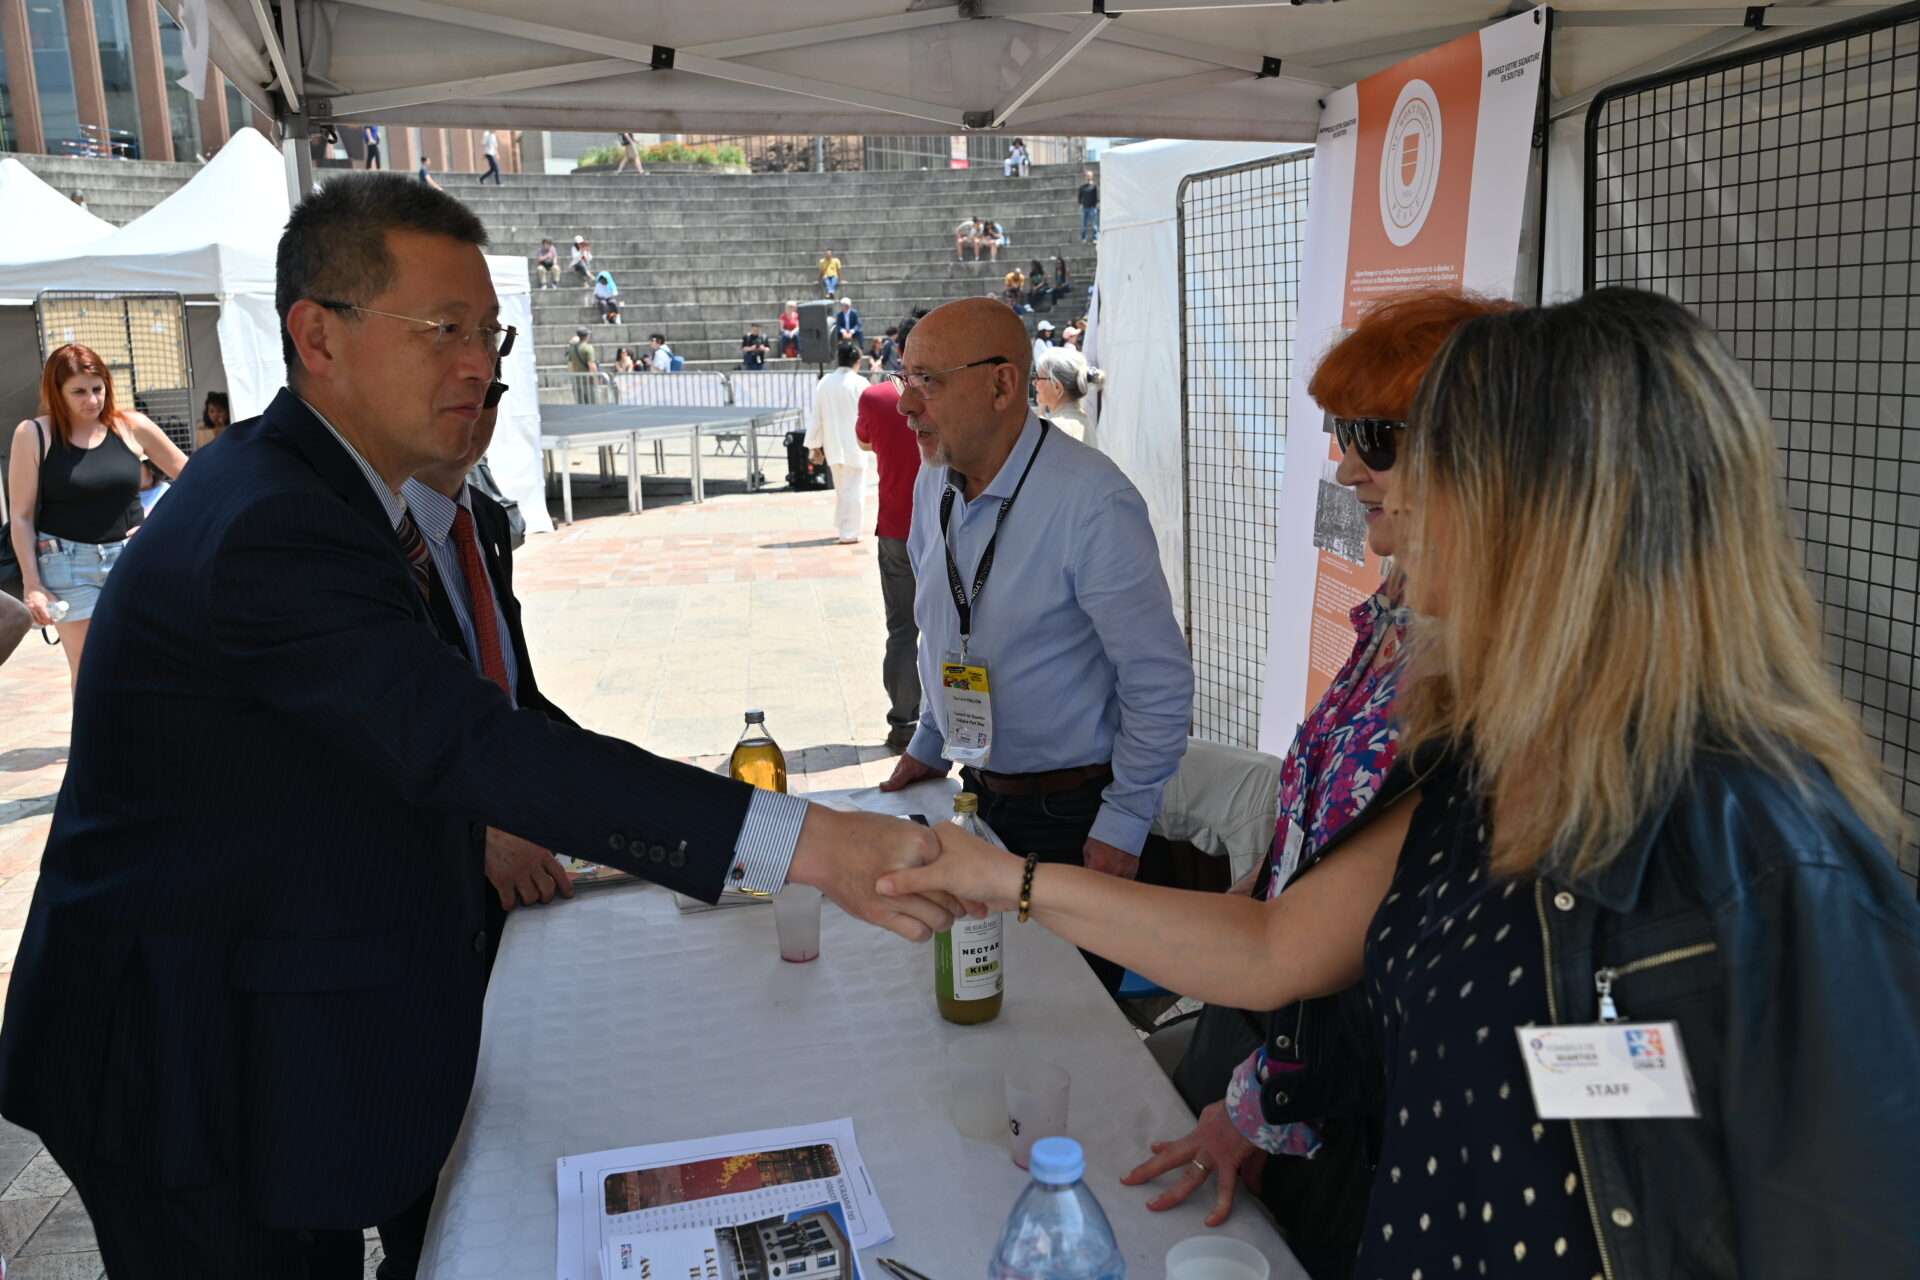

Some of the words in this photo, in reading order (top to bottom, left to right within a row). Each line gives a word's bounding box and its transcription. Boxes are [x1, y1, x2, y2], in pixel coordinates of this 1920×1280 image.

[975, 956, 988, 964] DE
[970, 964, 993, 974] KIWI
[1585, 1082, 1630, 1097] STAFF
